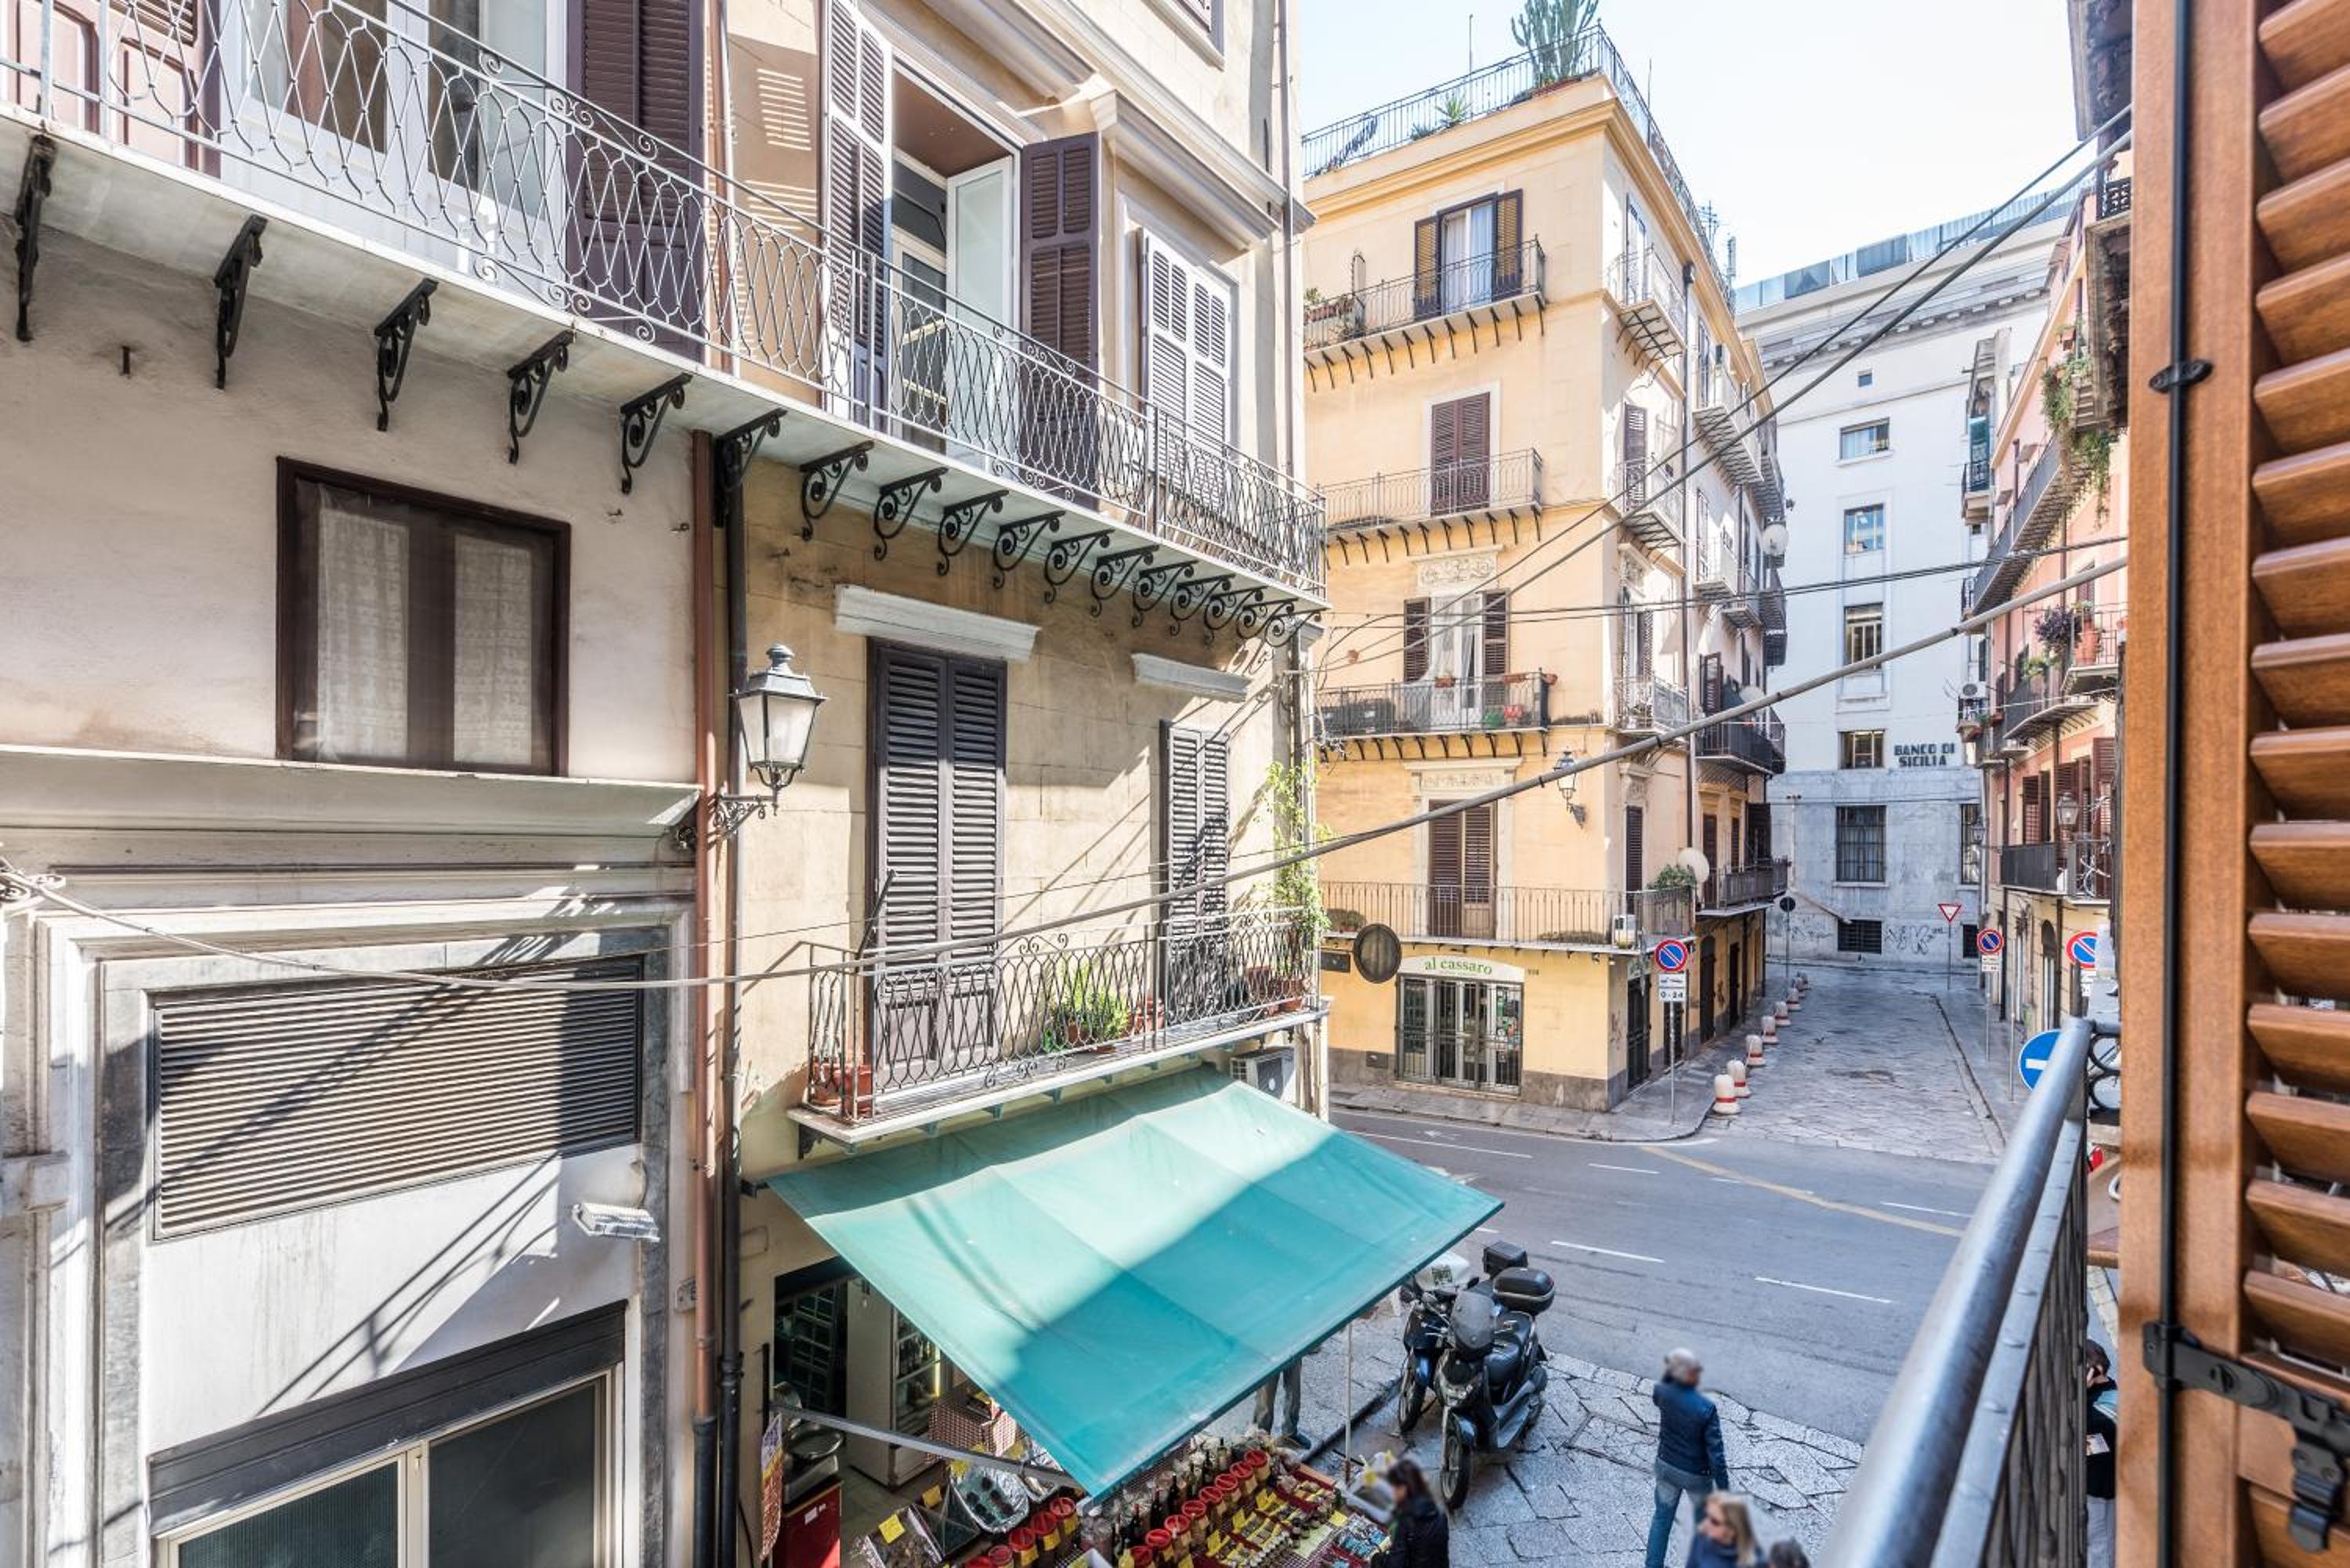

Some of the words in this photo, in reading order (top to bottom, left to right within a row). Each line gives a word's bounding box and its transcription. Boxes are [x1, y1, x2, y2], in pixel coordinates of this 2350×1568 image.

[1894, 744, 1936, 756] BANCO
[1942, 742, 1955, 754] DI
[1899, 755, 1947, 767] SICILIA
[1425, 957, 1436, 970] al
[1441, 959, 1491, 974] cassaro
